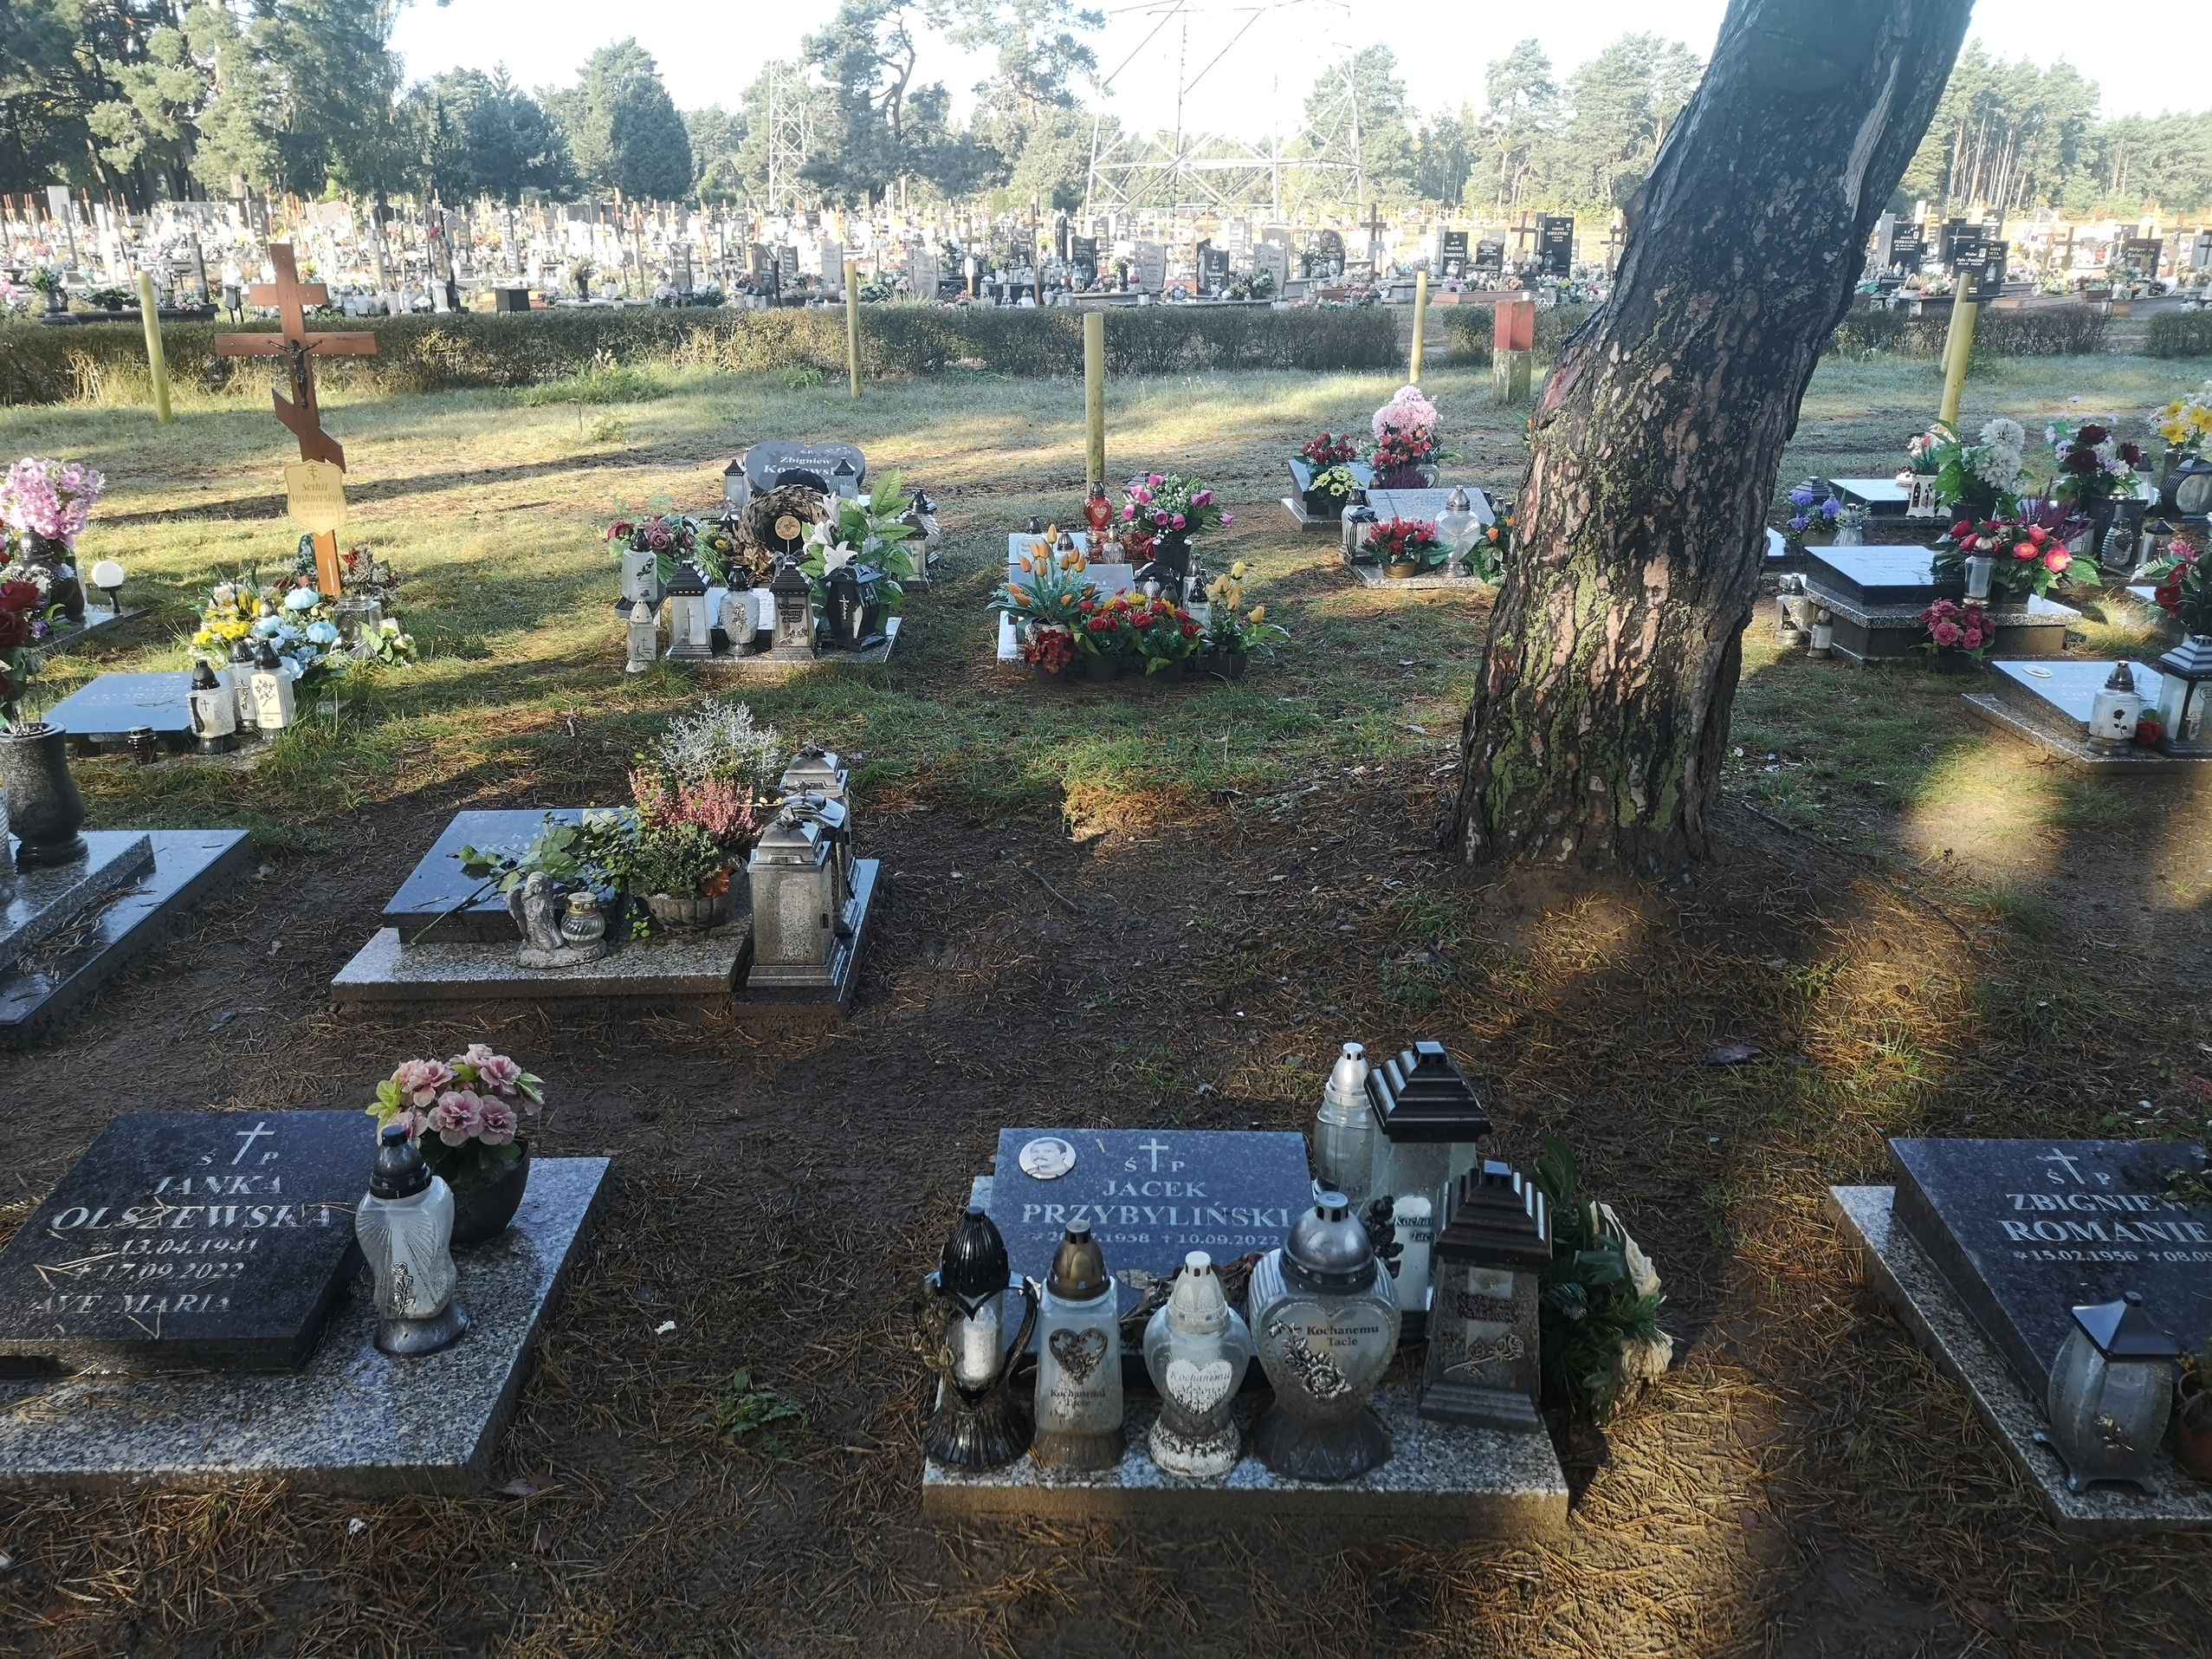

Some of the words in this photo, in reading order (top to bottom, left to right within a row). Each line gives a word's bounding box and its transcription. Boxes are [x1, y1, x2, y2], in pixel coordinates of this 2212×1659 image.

[1172, 1161, 1185, 1172] P
[147, 1176, 282, 1195] JANKA
[2092, 1172, 2111, 1185] P
[1103, 1181, 1207, 1197] JACEK
[51, 1205, 331, 1230] OLSZEWSKA
[1022, 1202, 1291, 1228] PRZYBYLIŃSKI
[35, 1294, 102, 1313] AVE
[113, 1294, 231, 1313] MARIA
[1306, 1325, 1380, 1335] Kochanemu
[1327, 1336, 1359, 1346] Tacie
